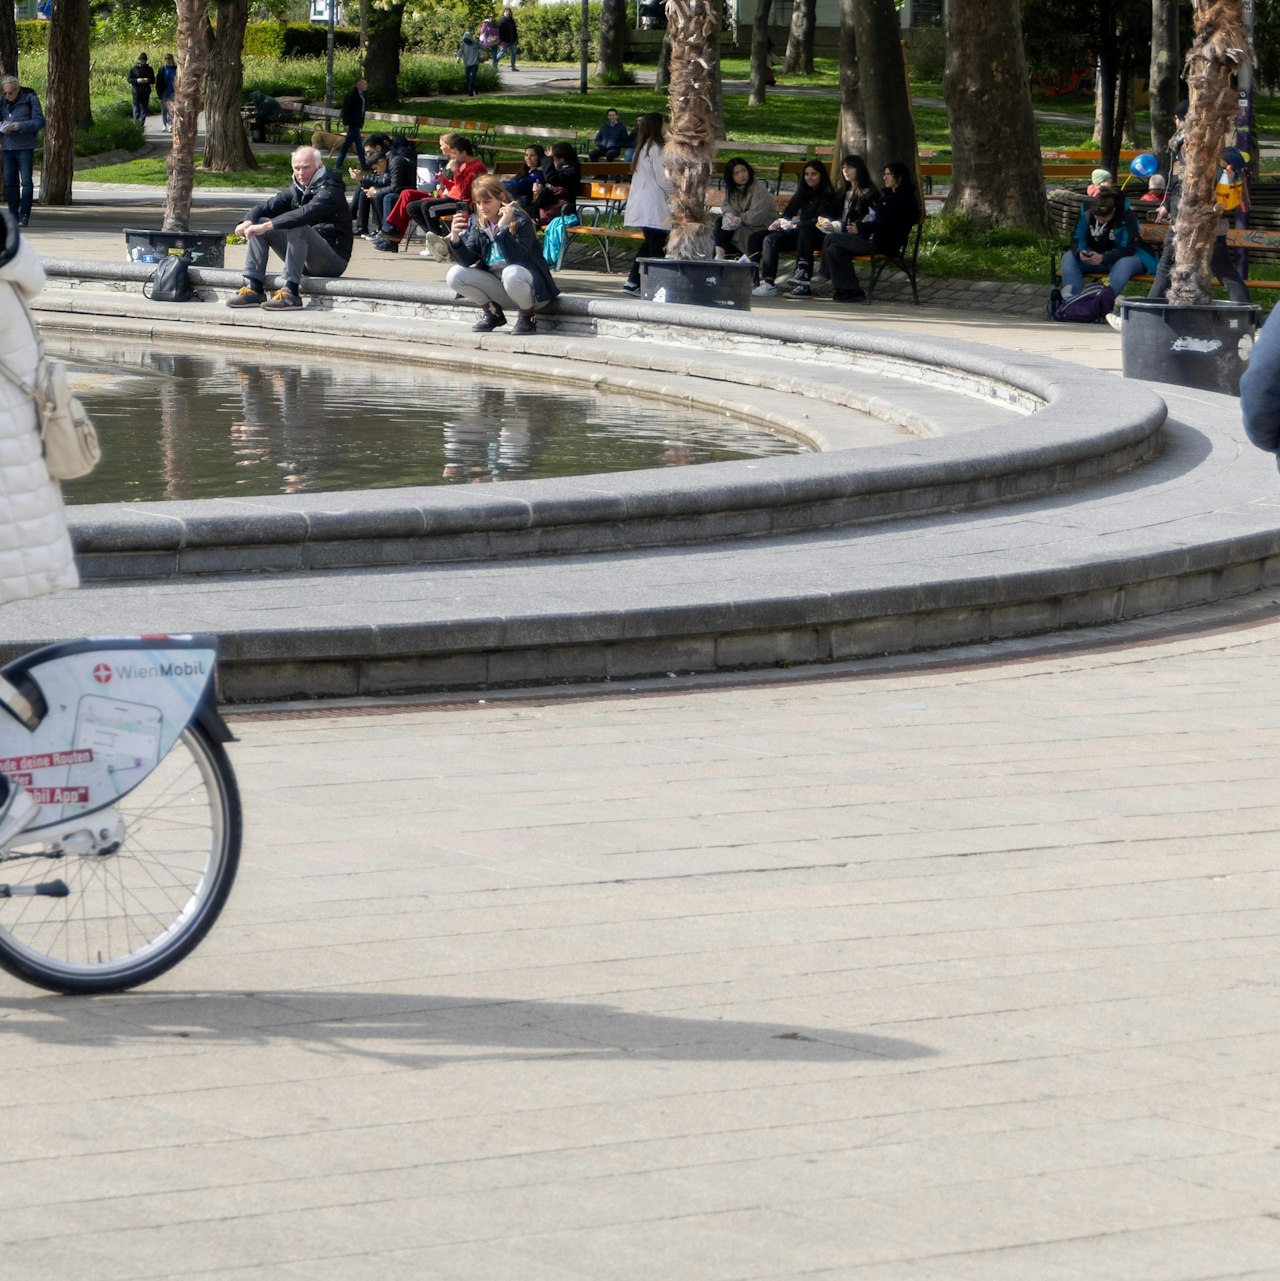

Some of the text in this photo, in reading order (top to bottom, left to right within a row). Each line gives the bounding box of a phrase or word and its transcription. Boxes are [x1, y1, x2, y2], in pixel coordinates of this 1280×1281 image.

[116, 661, 205, 680] WienMobil
[20, 756, 50, 769] deine
[52, 751, 90, 765] Routen
